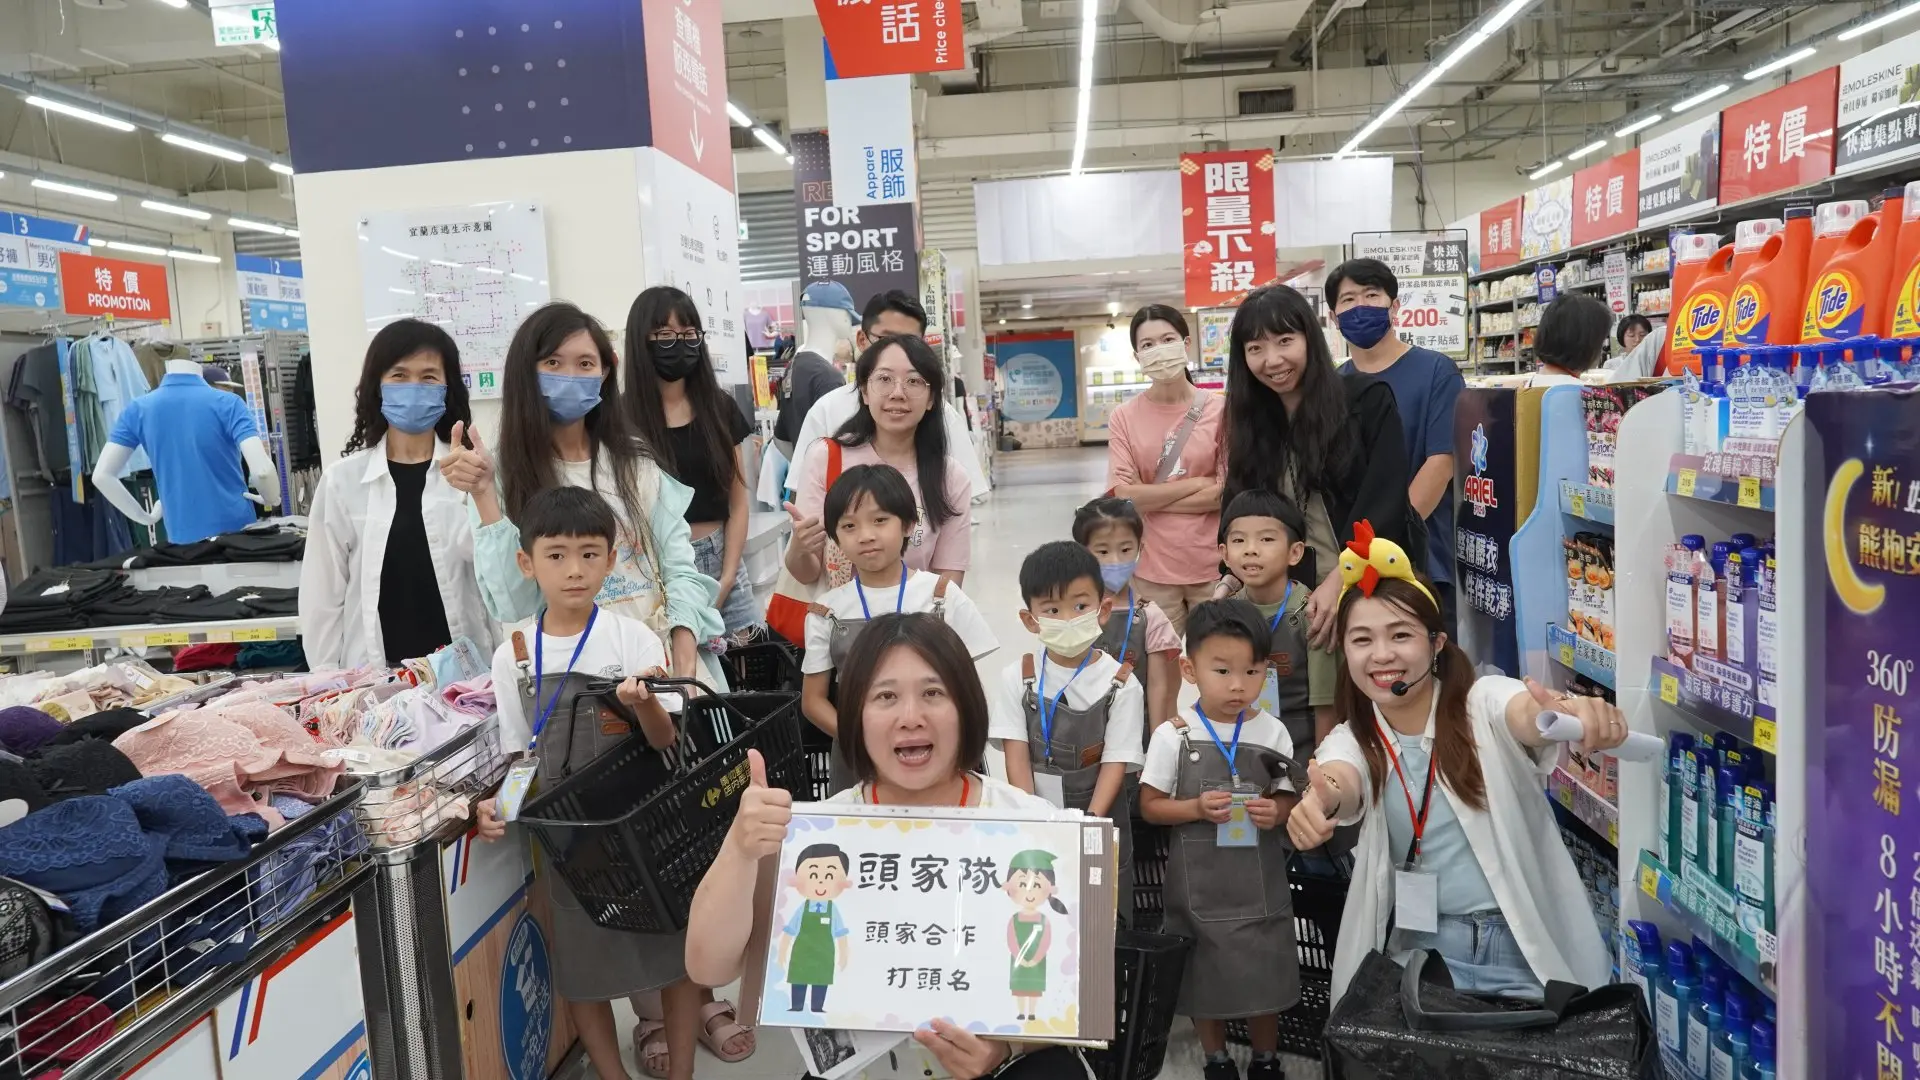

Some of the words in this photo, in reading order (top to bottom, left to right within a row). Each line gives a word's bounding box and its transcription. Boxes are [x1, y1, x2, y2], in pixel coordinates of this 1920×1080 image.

[934, 31, 947, 63] Price
[1848, 64, 1902, 94] MOLESKINE
[1743, 105, 1808, 173] 特價
[1846, 112, 1920, 157] 快速集點專
[863, 145, 879, 200] Apparel
[880, 148, 906, 200] 服飾
[1586, 175, 1624, 224] 特價
[19, 217, 28, 235] 3
[409, 221, 492, 237] 宜蘭店逃生示意圖
[804, 206, 861, 228] FOR
[1204, 161, 1256, 293] 限量下殺
[806, 227, 898, 252] SPORT
[1370, 245, 1423, 254] MOLESKINE
[1488, 217, 1513, 254] 特價
[807, 250, 905, 278] 運動風格
[1433, 244, 1459, 258] 快速
[1434, 259, 1459, 272] 集點
[94, 267, 140, 294] 特價
[88, 293, 151, 312] PROMOTION
[1735, 297, 1757, 327] Tide
[1818, 285, 1848, 321] Tide
[1691, 305, 1720, 333] Tide
[1416, 335, 1459, 345] 電子貼紙
[1464, 475, 1498, 508] ARIEL
[1744, 488, 1754, 497] 319
[1465, 571, 1511, 621] 件件乾淨
[1867, 649, 1914, 697] 360°
[1759, 729, 1771, 741] 349
[858, 852, 1002, 895] 頭家隊
[865, 920, 976, 946] 頭家合作
[887, 966, 971, 993] 打頭名
